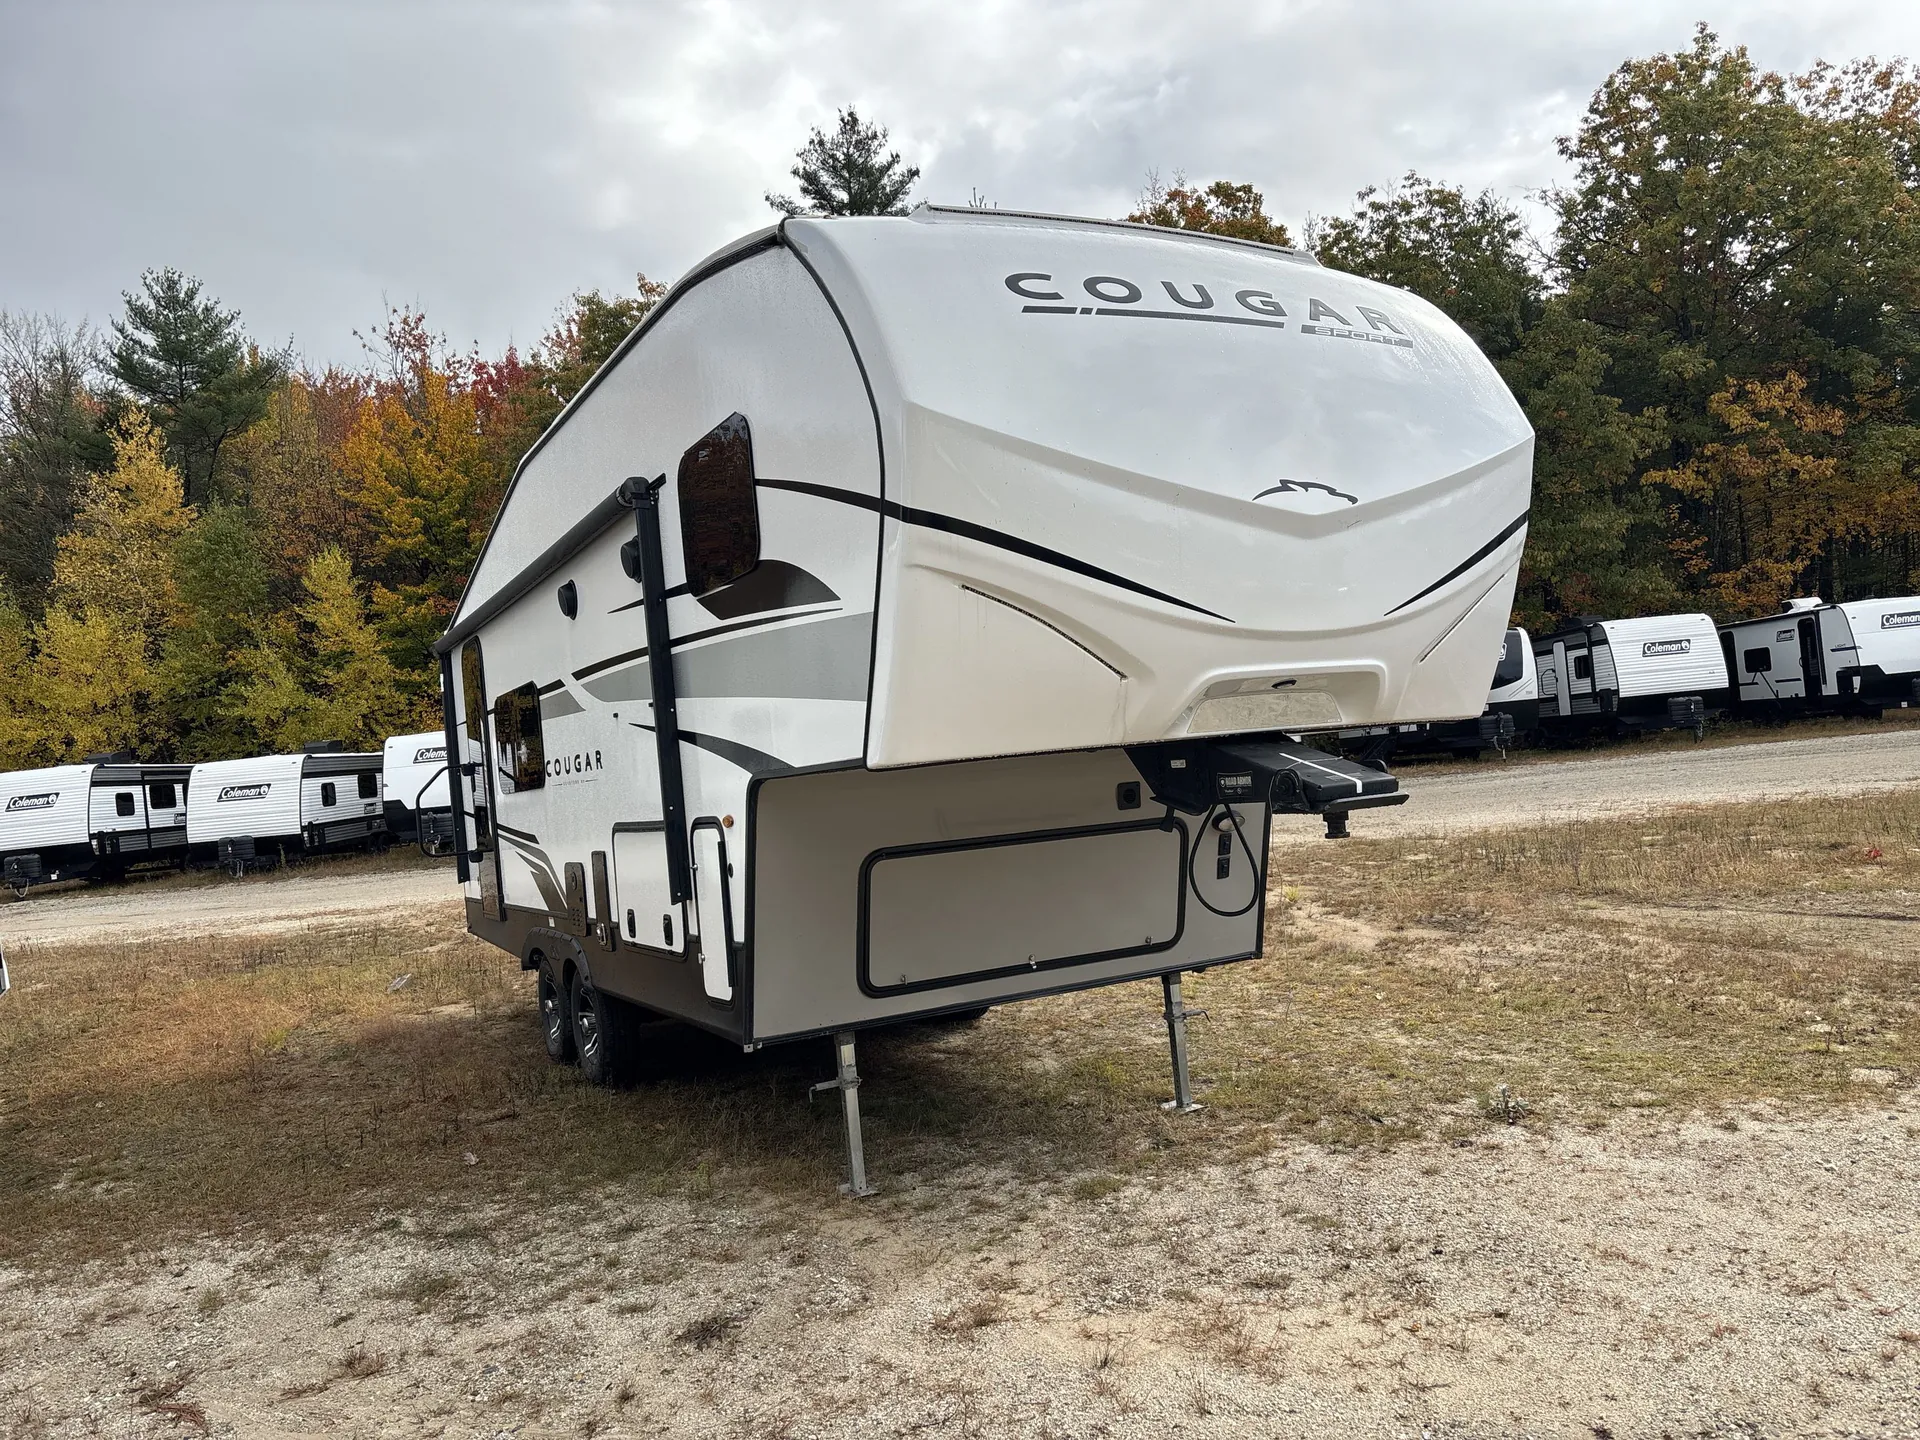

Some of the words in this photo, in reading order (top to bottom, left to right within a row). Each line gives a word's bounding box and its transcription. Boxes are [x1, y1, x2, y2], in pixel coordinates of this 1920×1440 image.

[1004, 272, 1405, 334] COUGAR
[1314, 326, 1400, 345] SPORT
[1883, 614, 1920, 626] Coleman
[1644, 643, 1681, 654] Coleman
[545, 750, 603, 777] COUGAR
[221, 787, 260, 799] Coleman
[9, 797, 48, 808] Coleman
